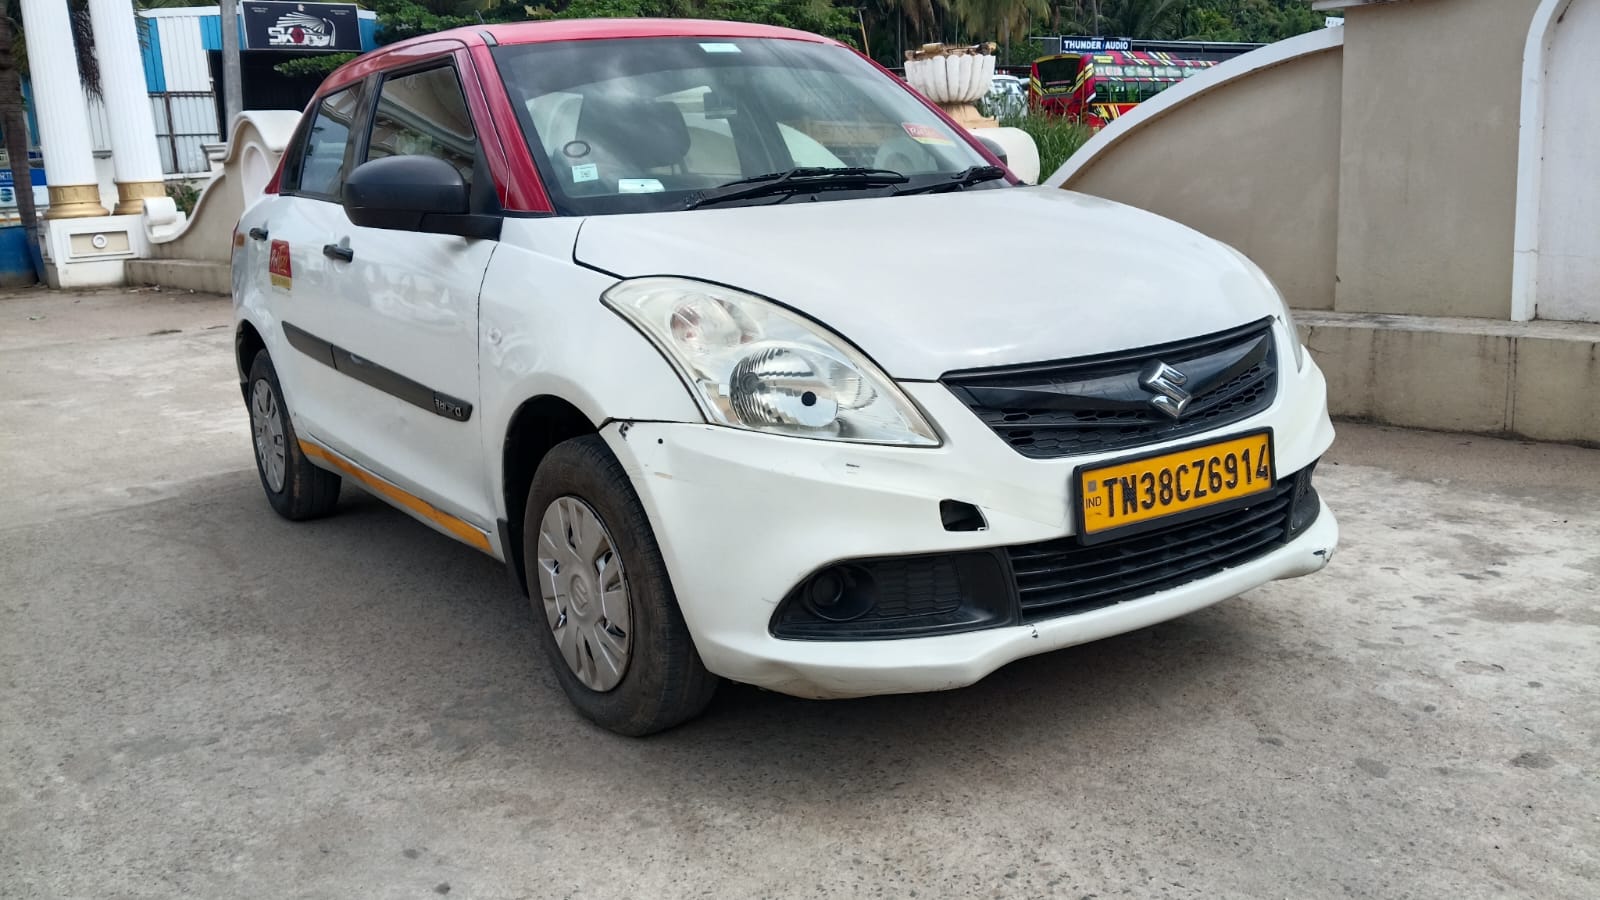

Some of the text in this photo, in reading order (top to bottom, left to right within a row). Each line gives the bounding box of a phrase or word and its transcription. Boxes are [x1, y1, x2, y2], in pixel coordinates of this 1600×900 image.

[1064, 40, 1128, 50] THUNDER AUDIO
[1102, 444, 1269, 517] TN38CZ6914
[1085, 496, 1102, 509] IND
